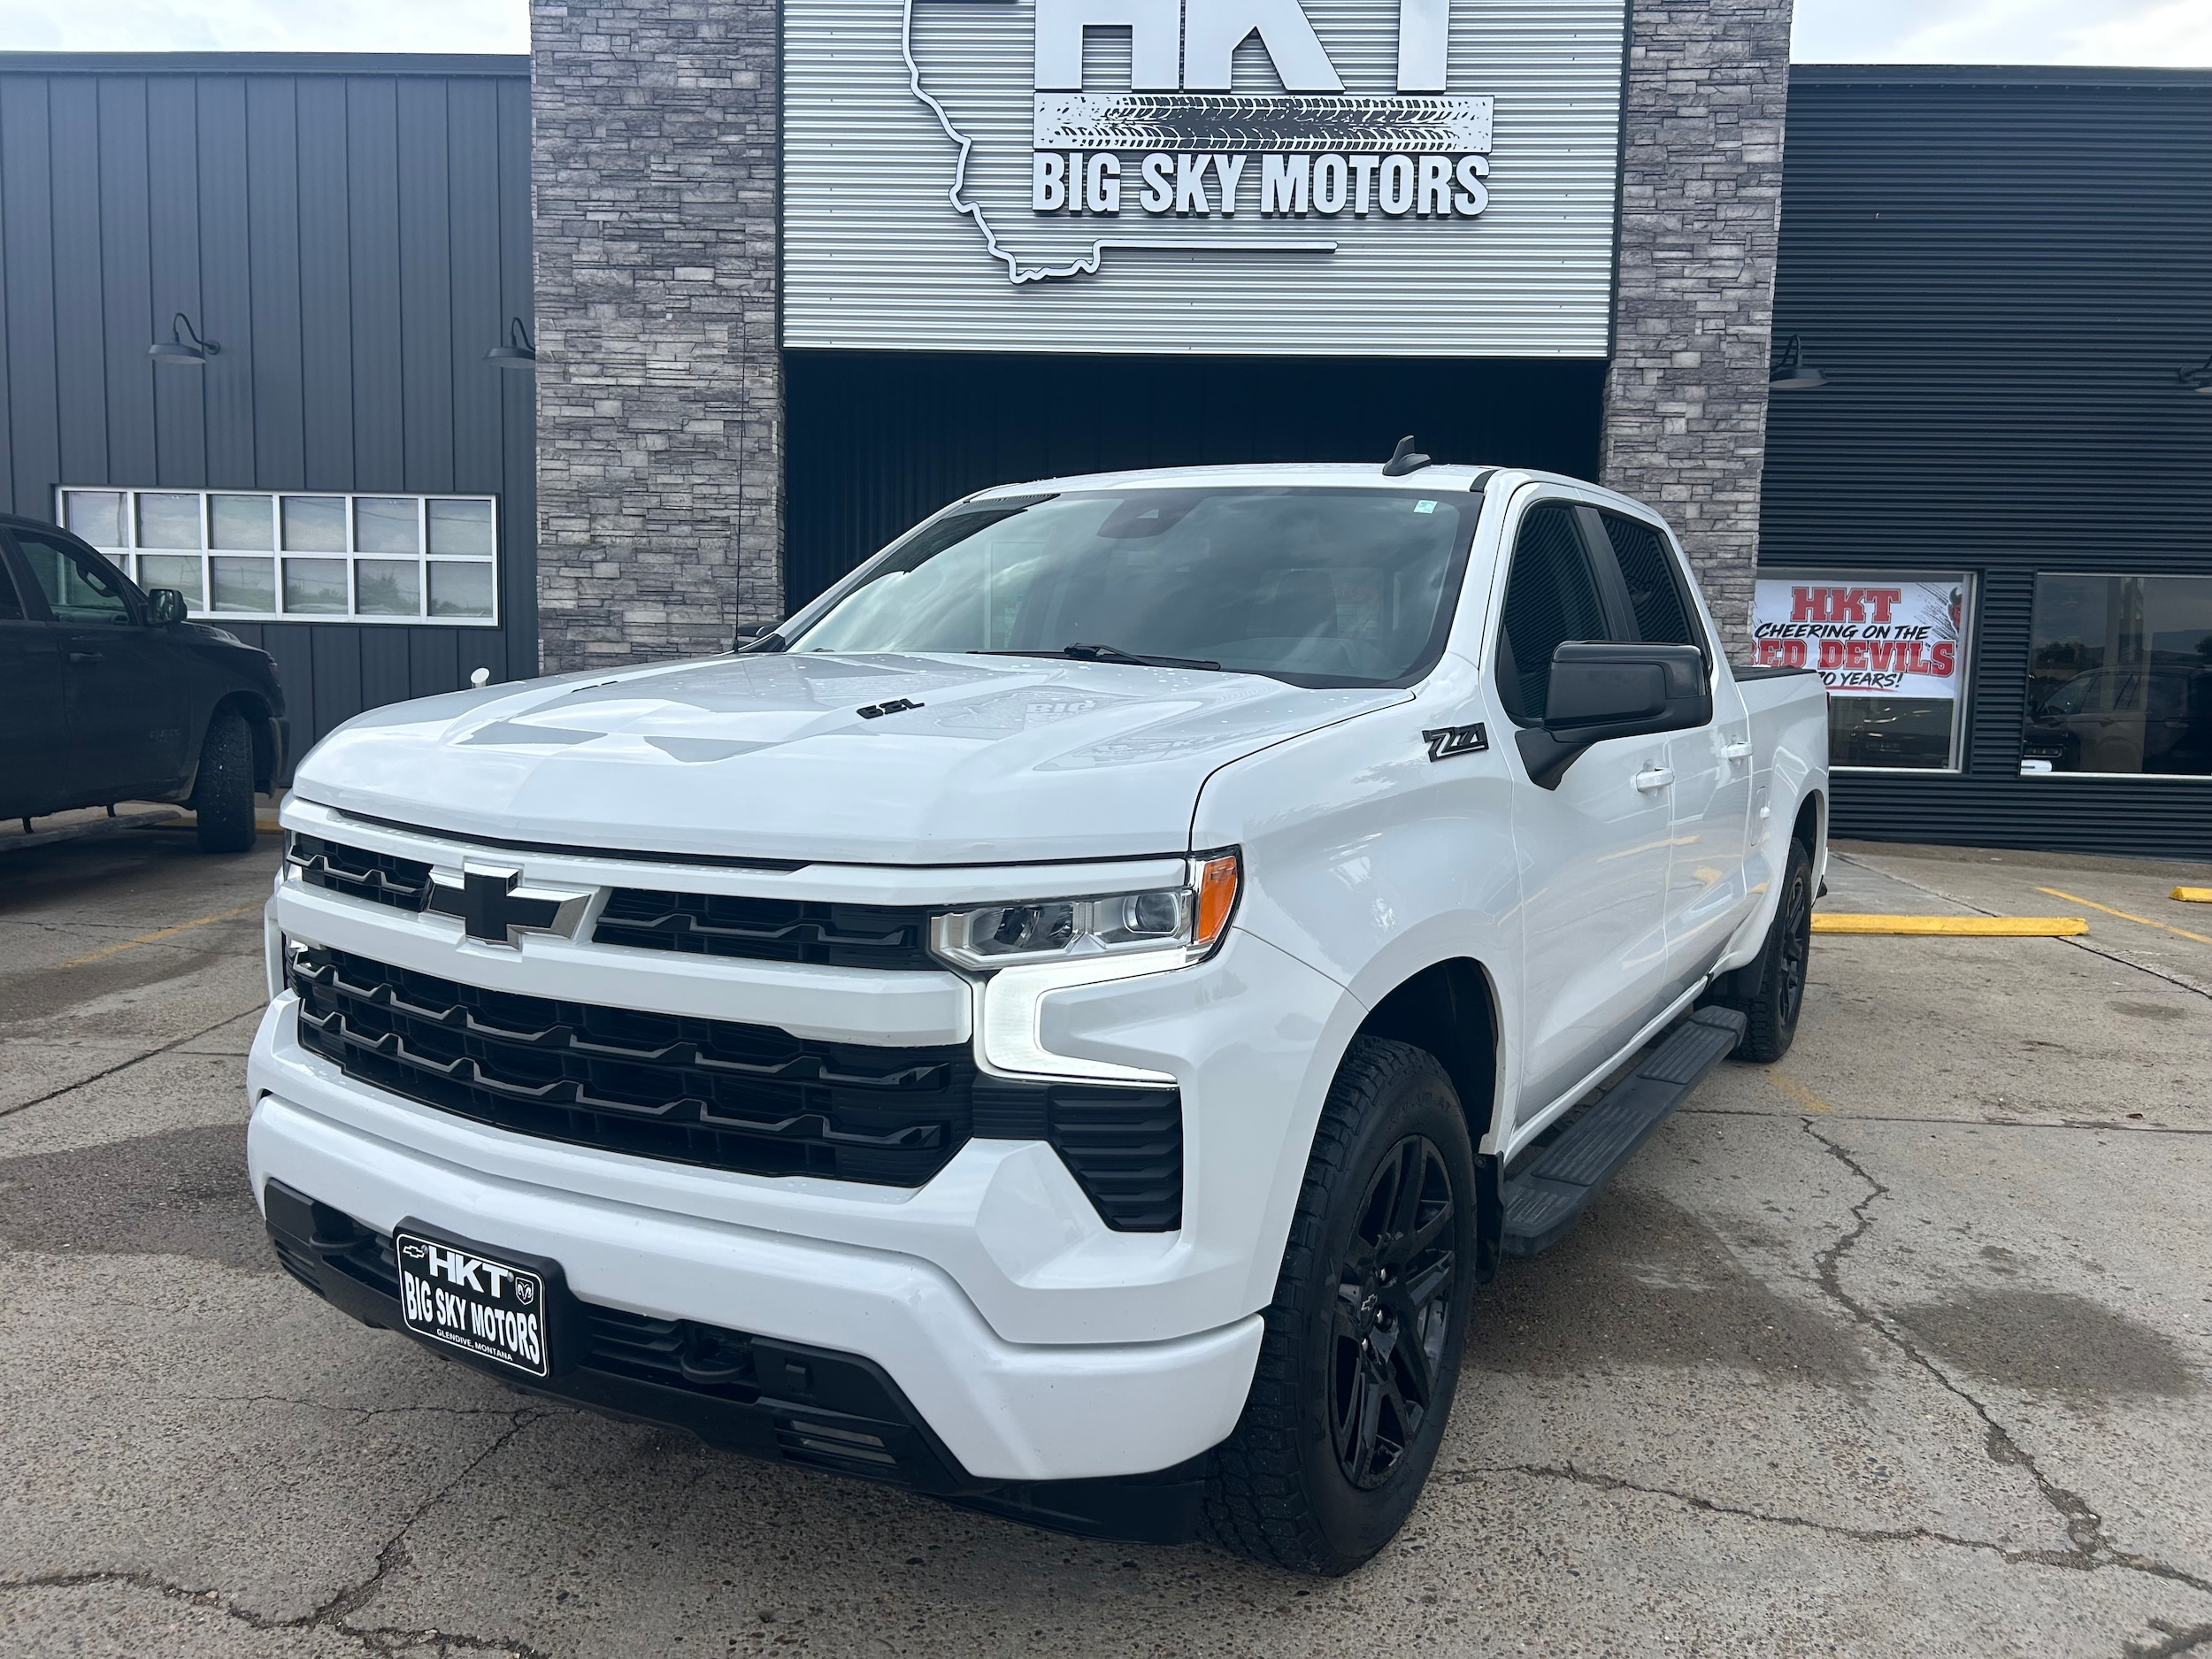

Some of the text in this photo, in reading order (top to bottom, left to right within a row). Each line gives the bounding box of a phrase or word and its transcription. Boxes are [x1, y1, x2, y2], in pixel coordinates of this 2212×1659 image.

[1032, 152, 1491, 217] BIG SKY MOTORS
[1790, 586, 1901, 624] HKT
[1755, 622, 1933, 640] CHEERING ON THE
[1750, 638, 1955, 678] ED DEVILS
[1840, 671, 1904, 688] YEARS!
[1421, 721, 1490, 763] Z71
[428, 1245, 510, 1298] HKT
[404, 1270, 541, 1364] BIG SKY MOTORS
[436, 1327, 513, 1362] GLENDIVE, MONTANA
